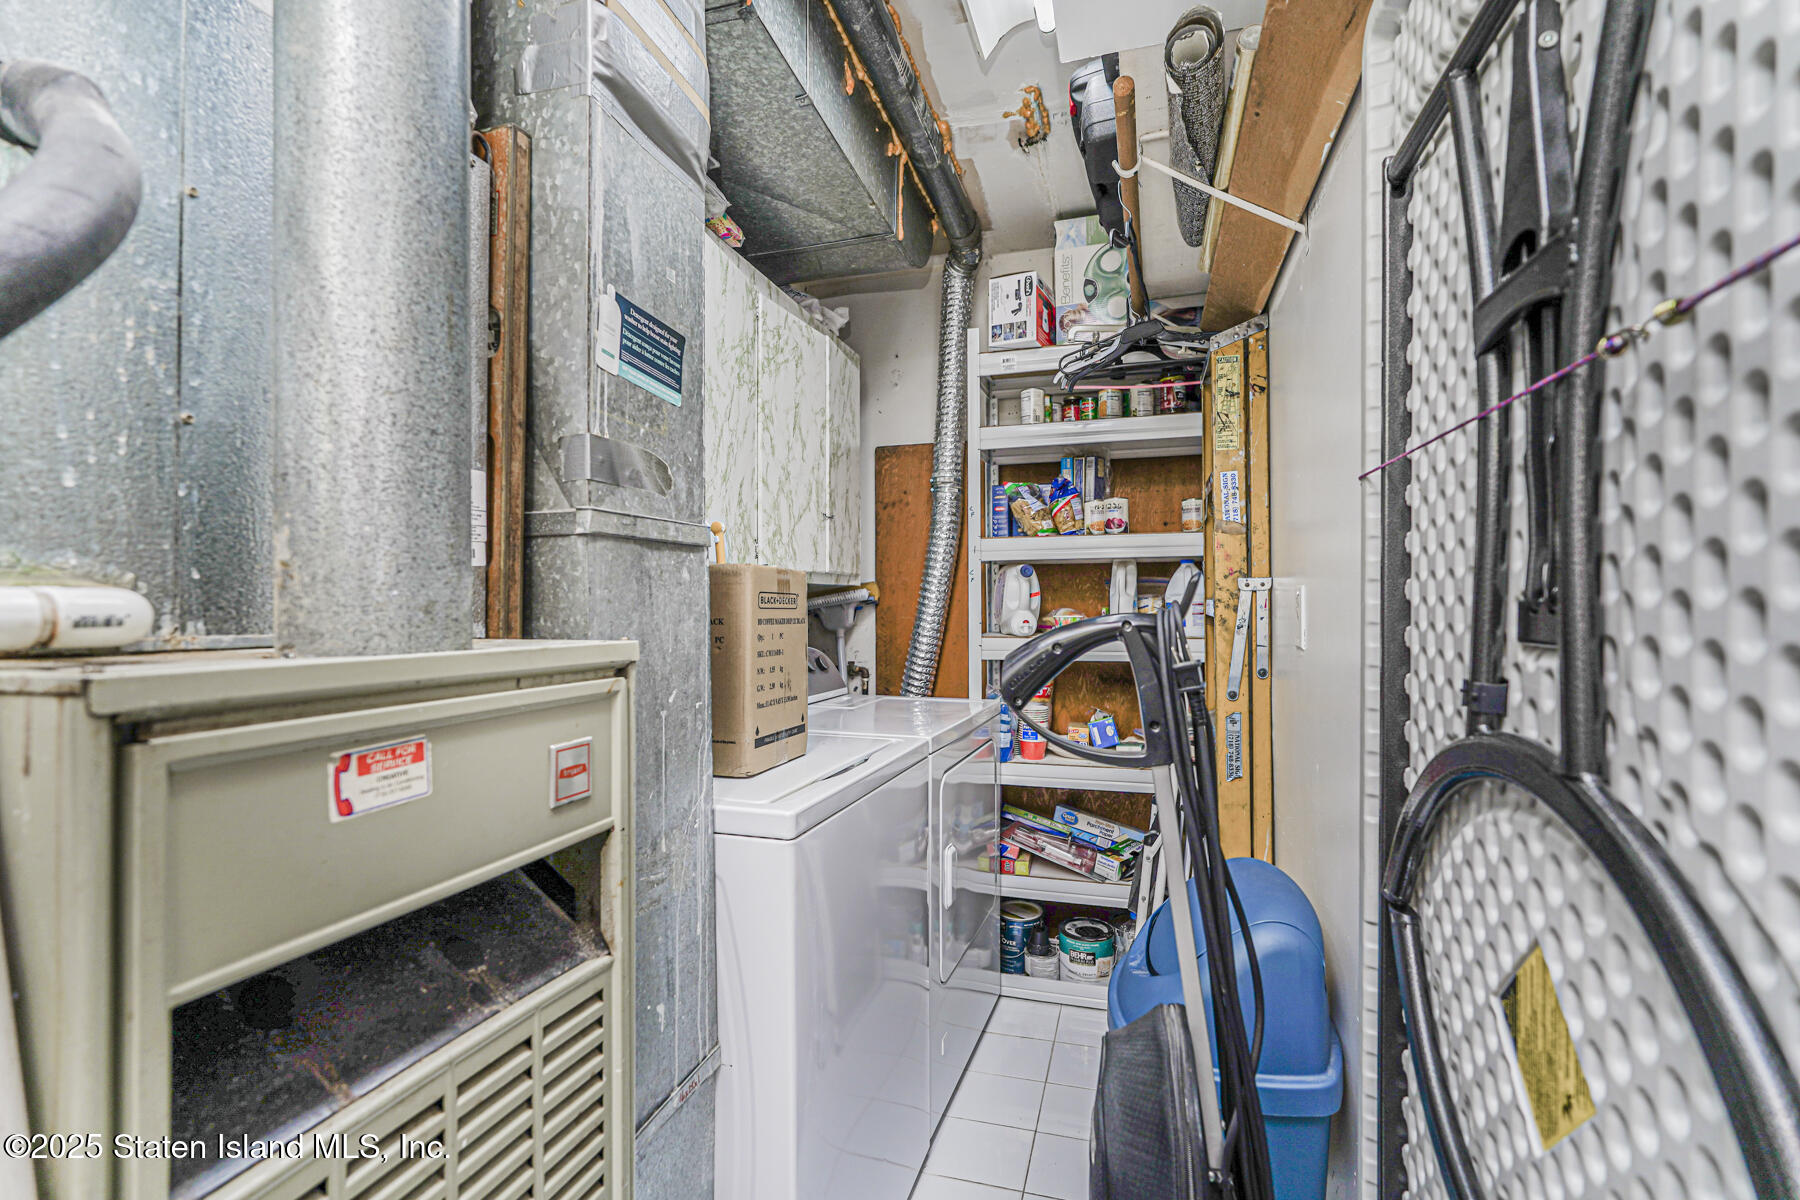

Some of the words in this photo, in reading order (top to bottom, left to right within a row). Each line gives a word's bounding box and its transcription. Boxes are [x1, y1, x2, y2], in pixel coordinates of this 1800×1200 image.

[1060, 256, 1070, 304] Benefits
[760, 596, 796, 605] BLACK+DECKER
[1070, 949, 1087, 960] BEHR
